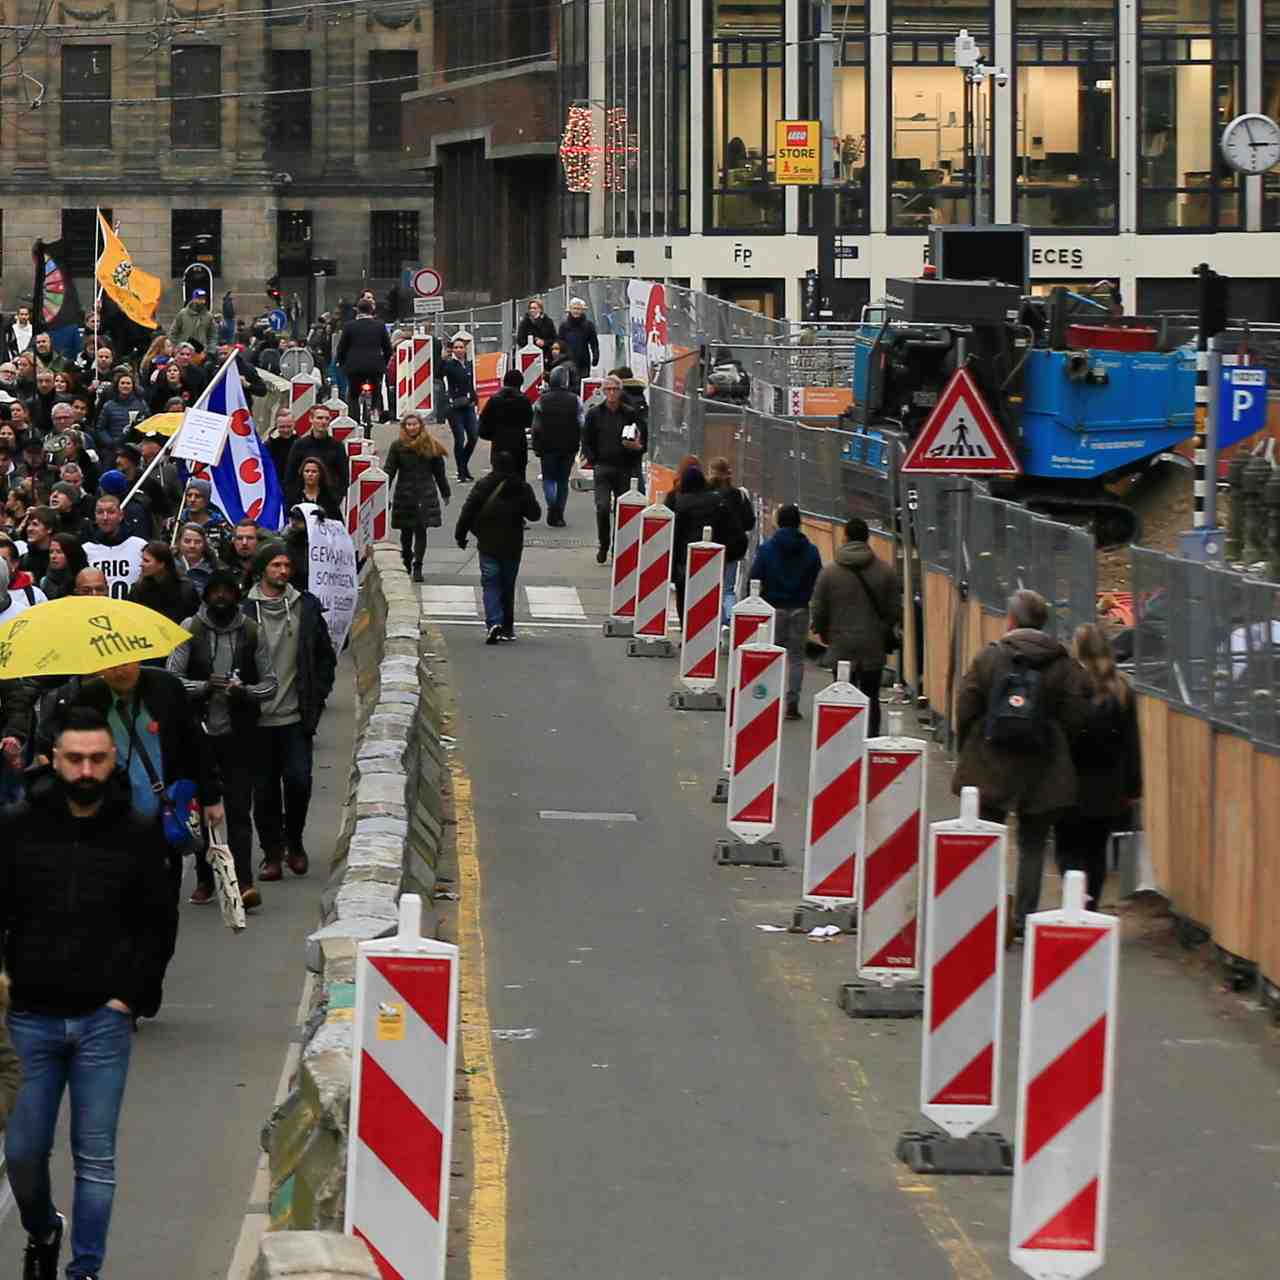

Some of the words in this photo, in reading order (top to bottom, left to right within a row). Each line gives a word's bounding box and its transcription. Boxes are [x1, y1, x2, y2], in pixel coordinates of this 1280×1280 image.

[779, 148, 816, 159] STORE
[1032, 249, 1083, 268] ECES
[1232, 390, 1253, 422] P
